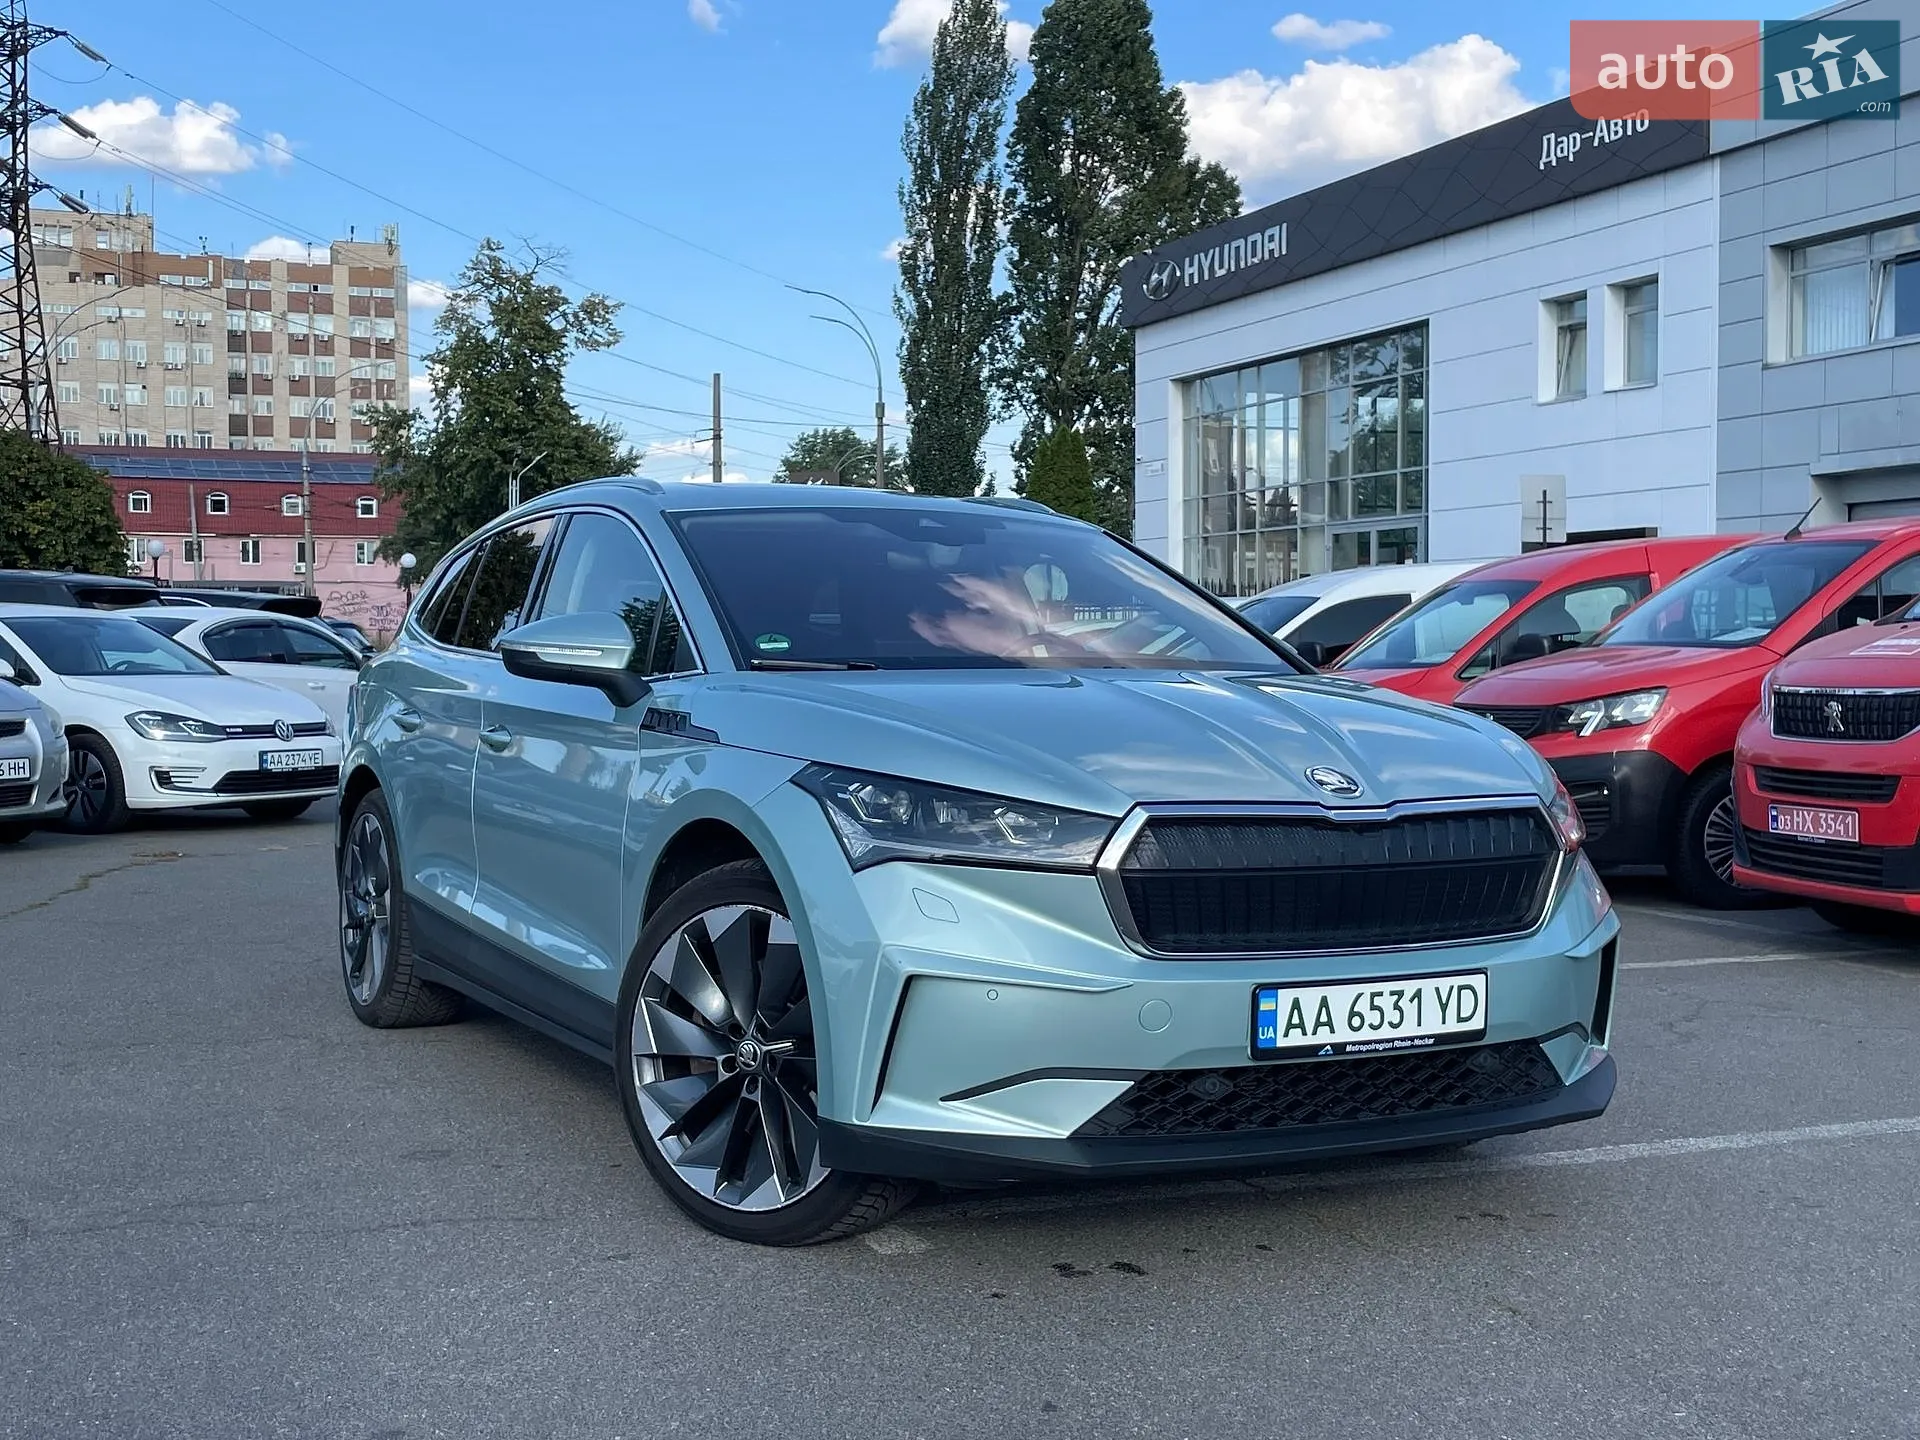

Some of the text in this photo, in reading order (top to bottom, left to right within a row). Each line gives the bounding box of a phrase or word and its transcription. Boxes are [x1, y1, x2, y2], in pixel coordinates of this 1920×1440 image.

[1538, 108, 1650, 171] Дар-Авто
[1183, 222, 1288, 287] HYUNDAI
[8, 761, 26, 776] HH
[269, 754, 283, 767] AA
[285, 752, 307, 766] 2374
[308, 752, 320, 765] YE
[1778, 809, 1853, 836] 03 HX 3541
[1283, 983, 1479, 1038] AA 6531 YD
[1259, 1026, 1275, 1039] UA
